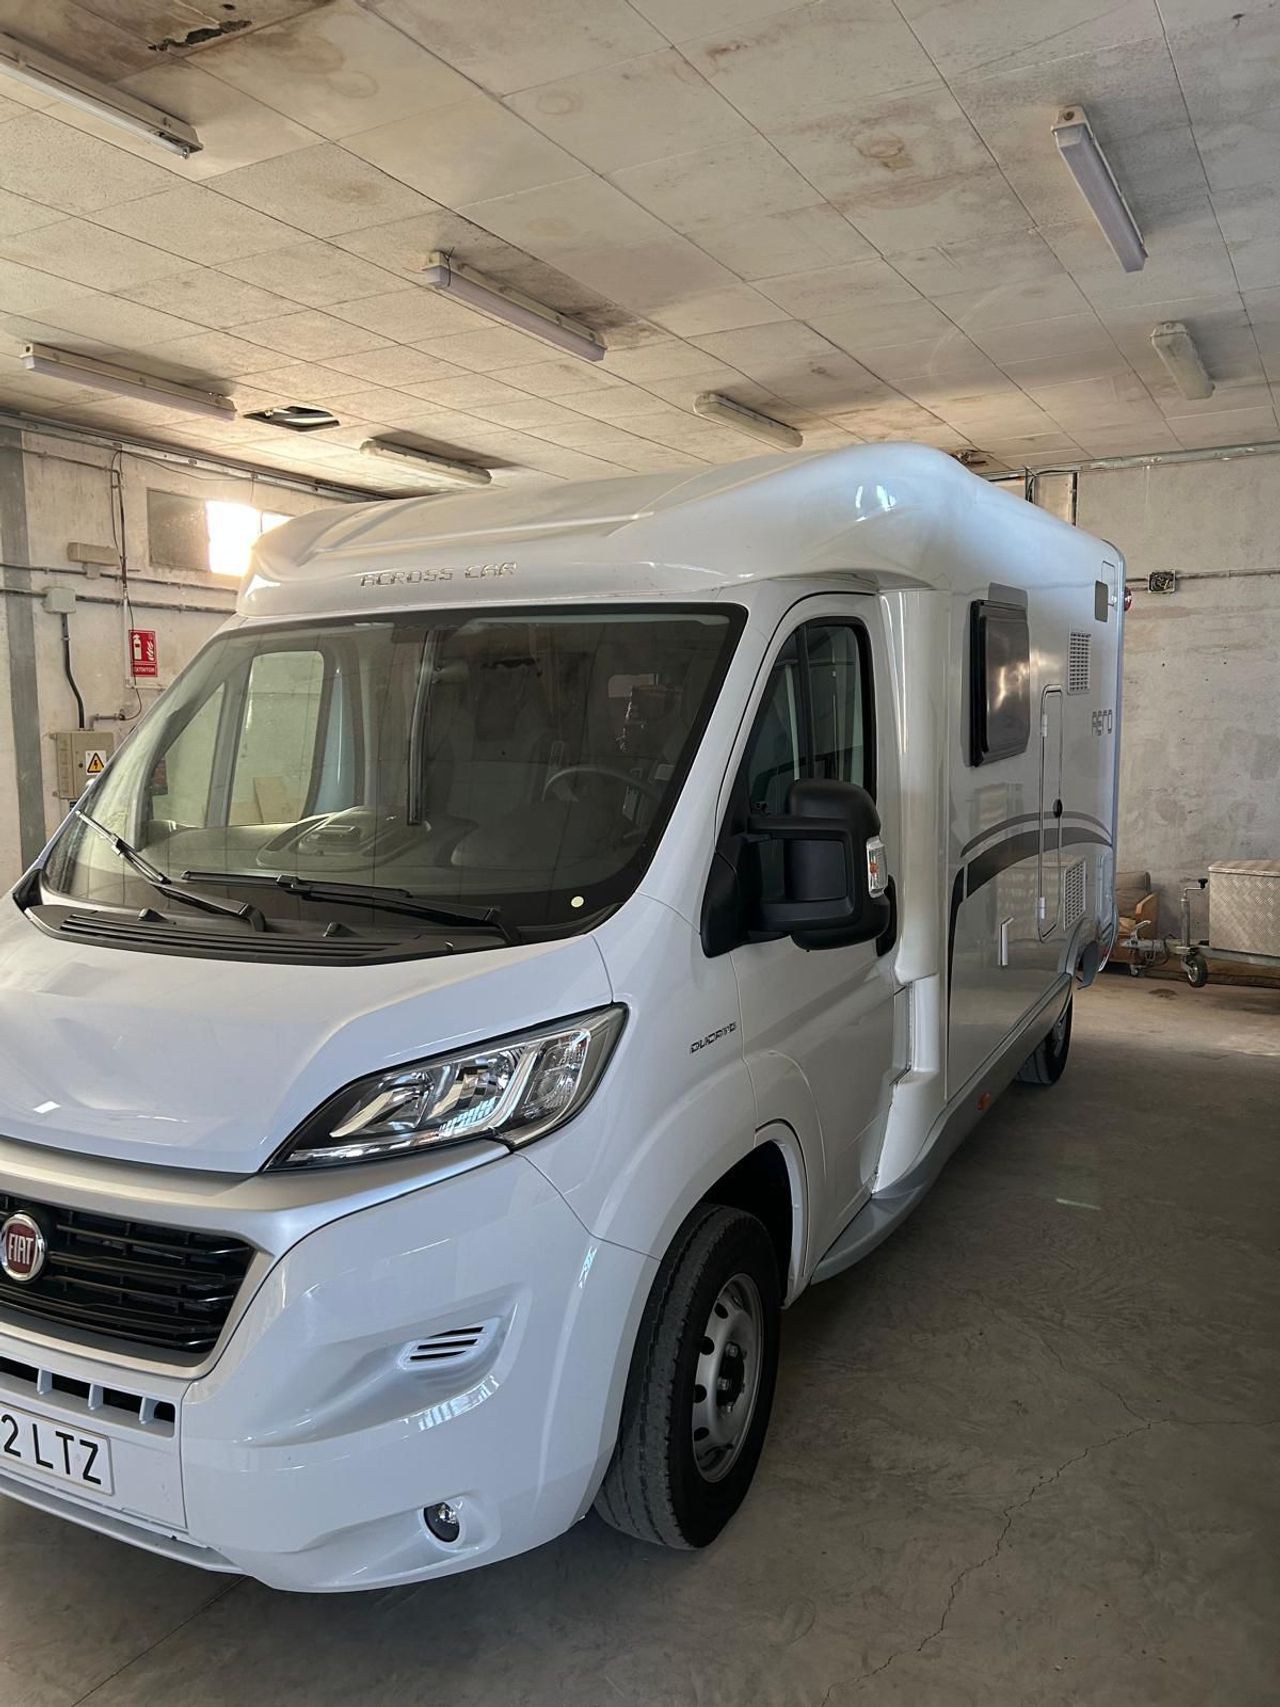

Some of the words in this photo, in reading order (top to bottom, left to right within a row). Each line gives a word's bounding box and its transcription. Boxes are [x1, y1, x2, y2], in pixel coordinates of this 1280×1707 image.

[361, 568, 455, 587] ACROSS
[465, 561, 517, 579] CAR
[690, 1021, 737, 1053] DUCATO
[8, 1232, 34, 1265] FIAT
[1, 1414, 21, 1457] 2
[32, 1423, 101, 1485] LTZ
